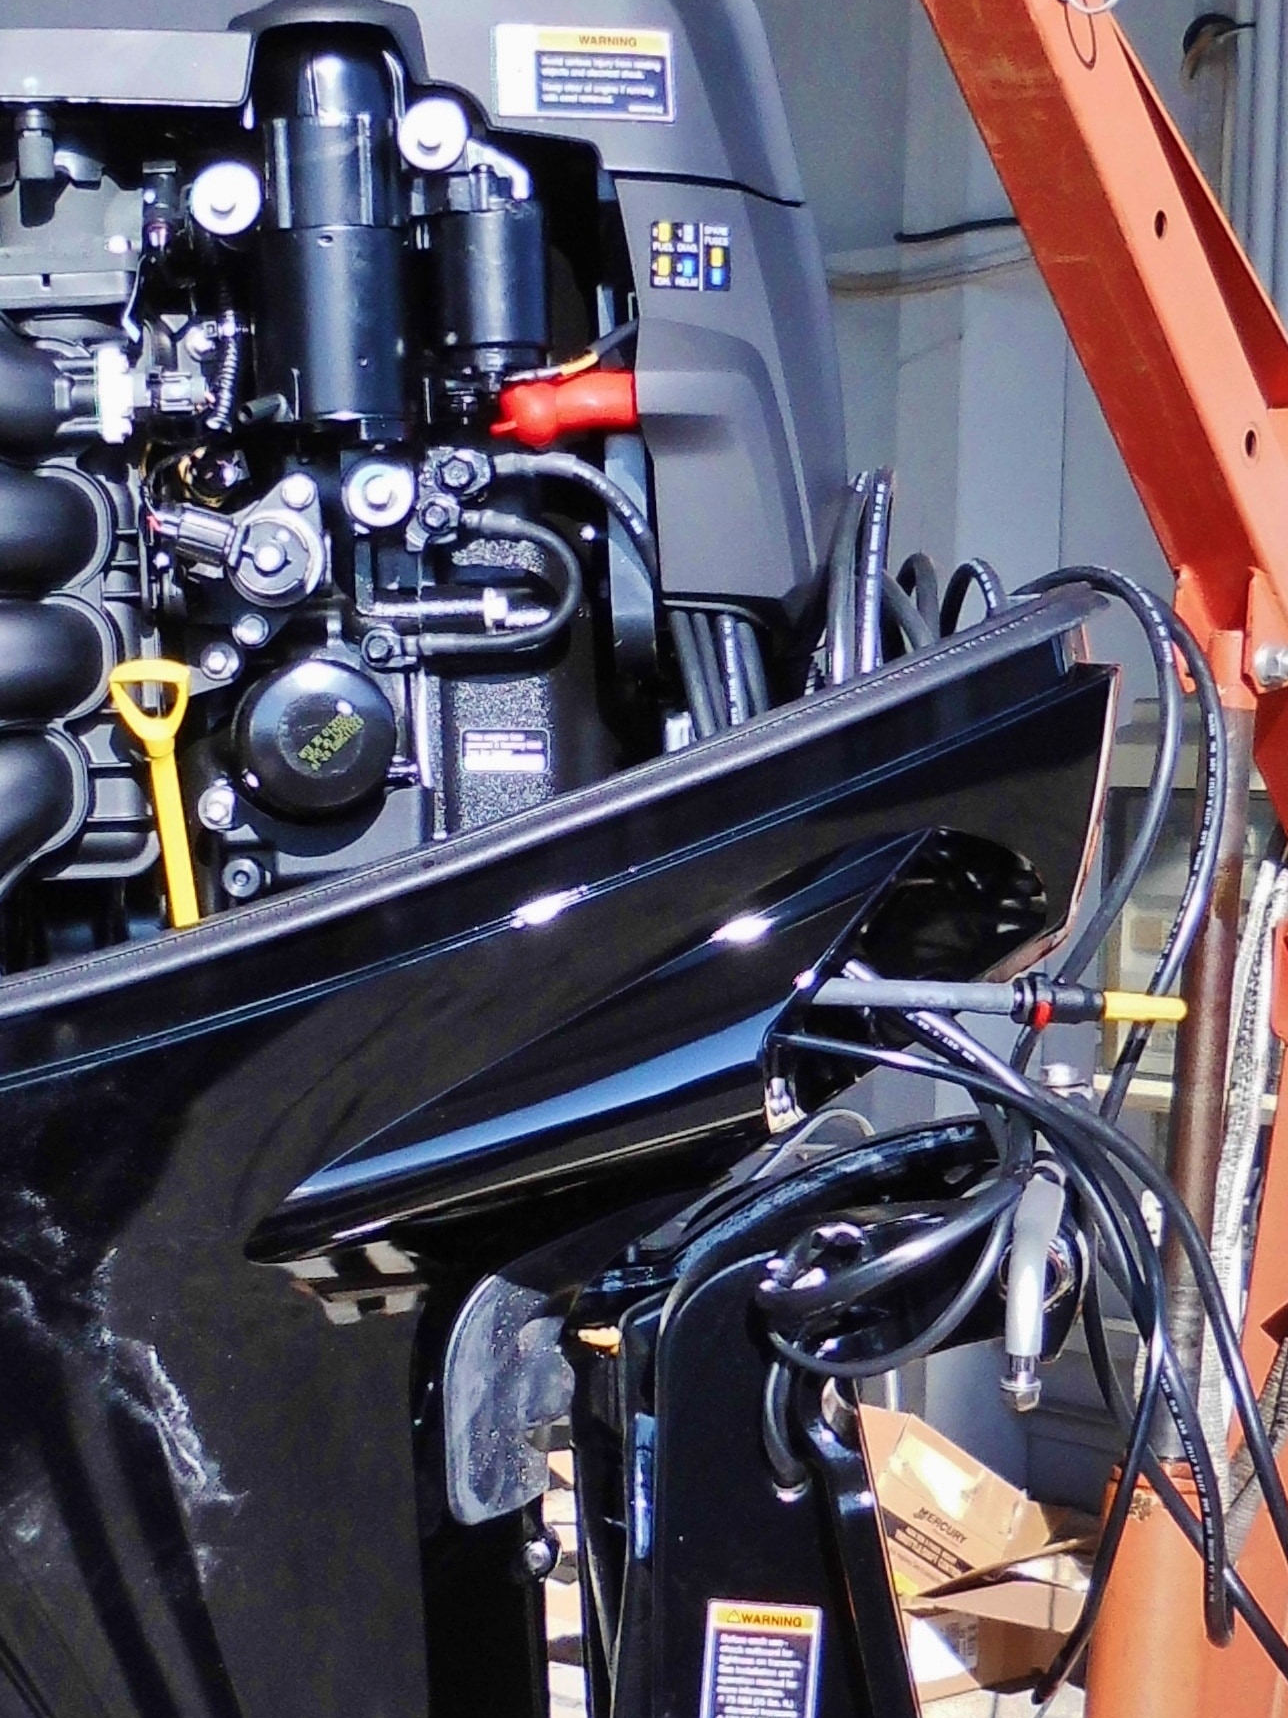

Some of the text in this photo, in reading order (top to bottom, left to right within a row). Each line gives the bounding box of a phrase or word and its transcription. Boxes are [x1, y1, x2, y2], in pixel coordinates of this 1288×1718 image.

[579, 35, 637, 47] WARNING
[914, 1507, 968, 1544] MERCURY
[741, 1613, 803, 1628] WARNING
